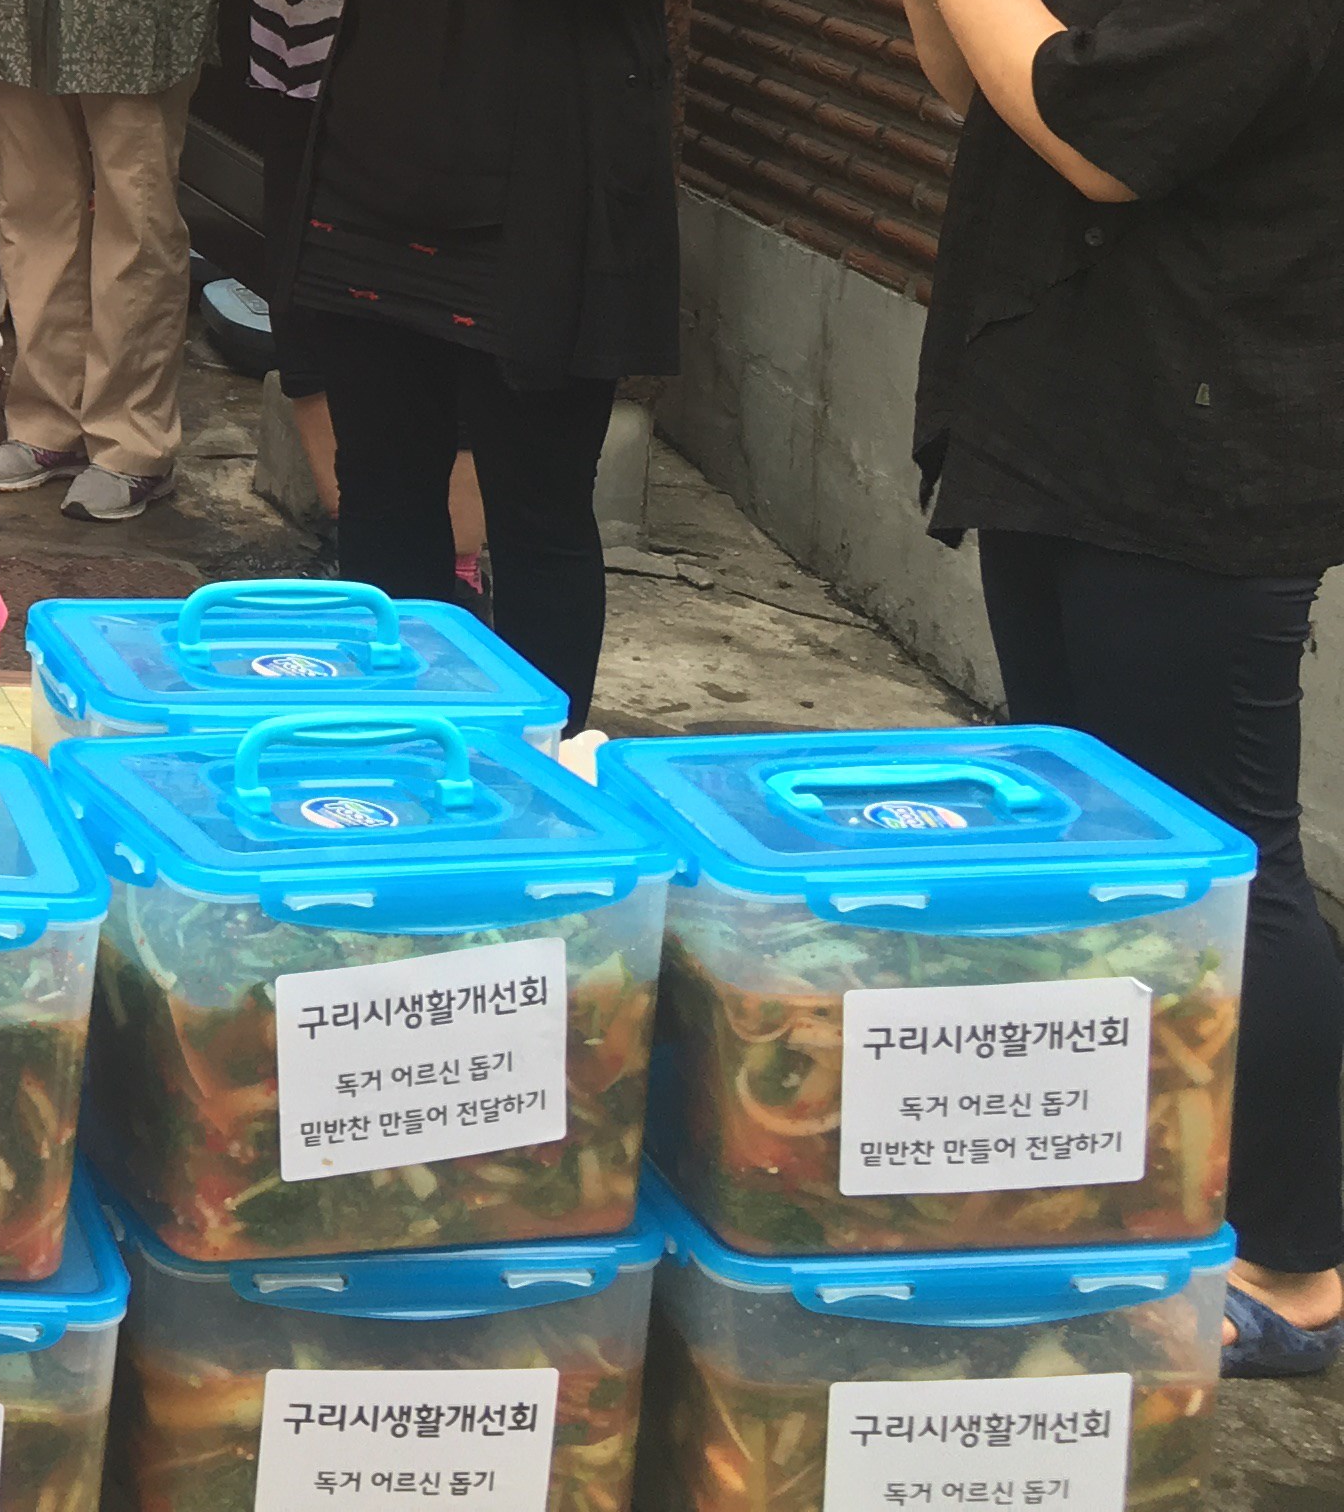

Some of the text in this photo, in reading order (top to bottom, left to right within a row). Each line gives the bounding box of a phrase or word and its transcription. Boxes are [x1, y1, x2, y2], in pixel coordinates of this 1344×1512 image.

[297, 975, 549, 1040] 구리시생활개선회
[862, 1016, 1130, 1061] 구리시생활개선회
[335, 1050, 514, 1098] 독거 어르신 돕기
[300, 1089, 548, 1148] 밑반찬 만들어 전달하기
[898, 1088, 1089, 1122] 독거 어르신 돕기
[860, 1130, 1123, 1168] 밑반찬 만들어 전달하기
[283, 1402, 539, 1439] 구리시생활개선회
[849, 1408, 1112, 1449] 구리시생활개선회
[314, 1470, 496, 1497] 독거 어르신 돕기
[883, 1478, 1070, 1507] 독거 어르신 돕기
